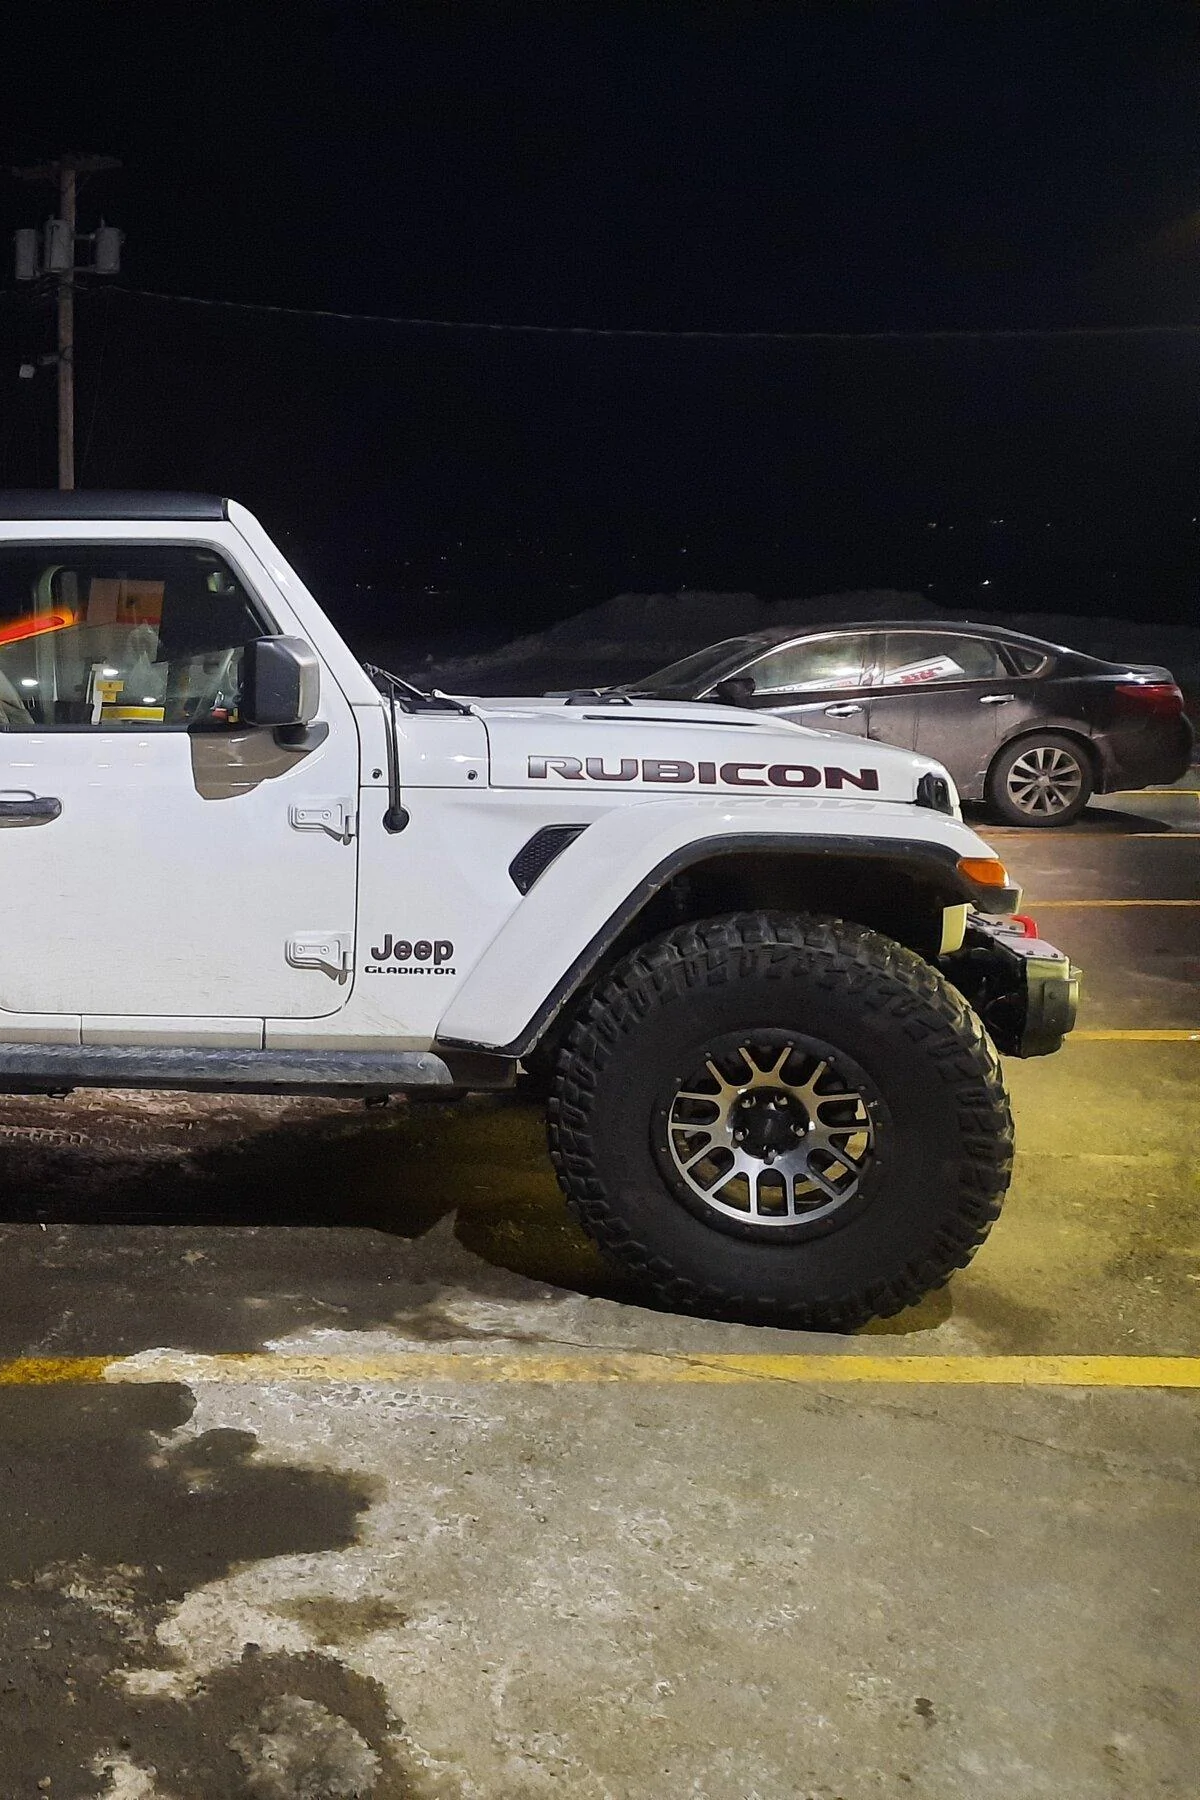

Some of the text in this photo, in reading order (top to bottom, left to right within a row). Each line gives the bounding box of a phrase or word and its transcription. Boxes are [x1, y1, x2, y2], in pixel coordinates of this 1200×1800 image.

[528, 755, 879, 791] RUBICON
[371, 934, 454, 965] Jeep
[364, 965, 456, 975] GLADIATOR
